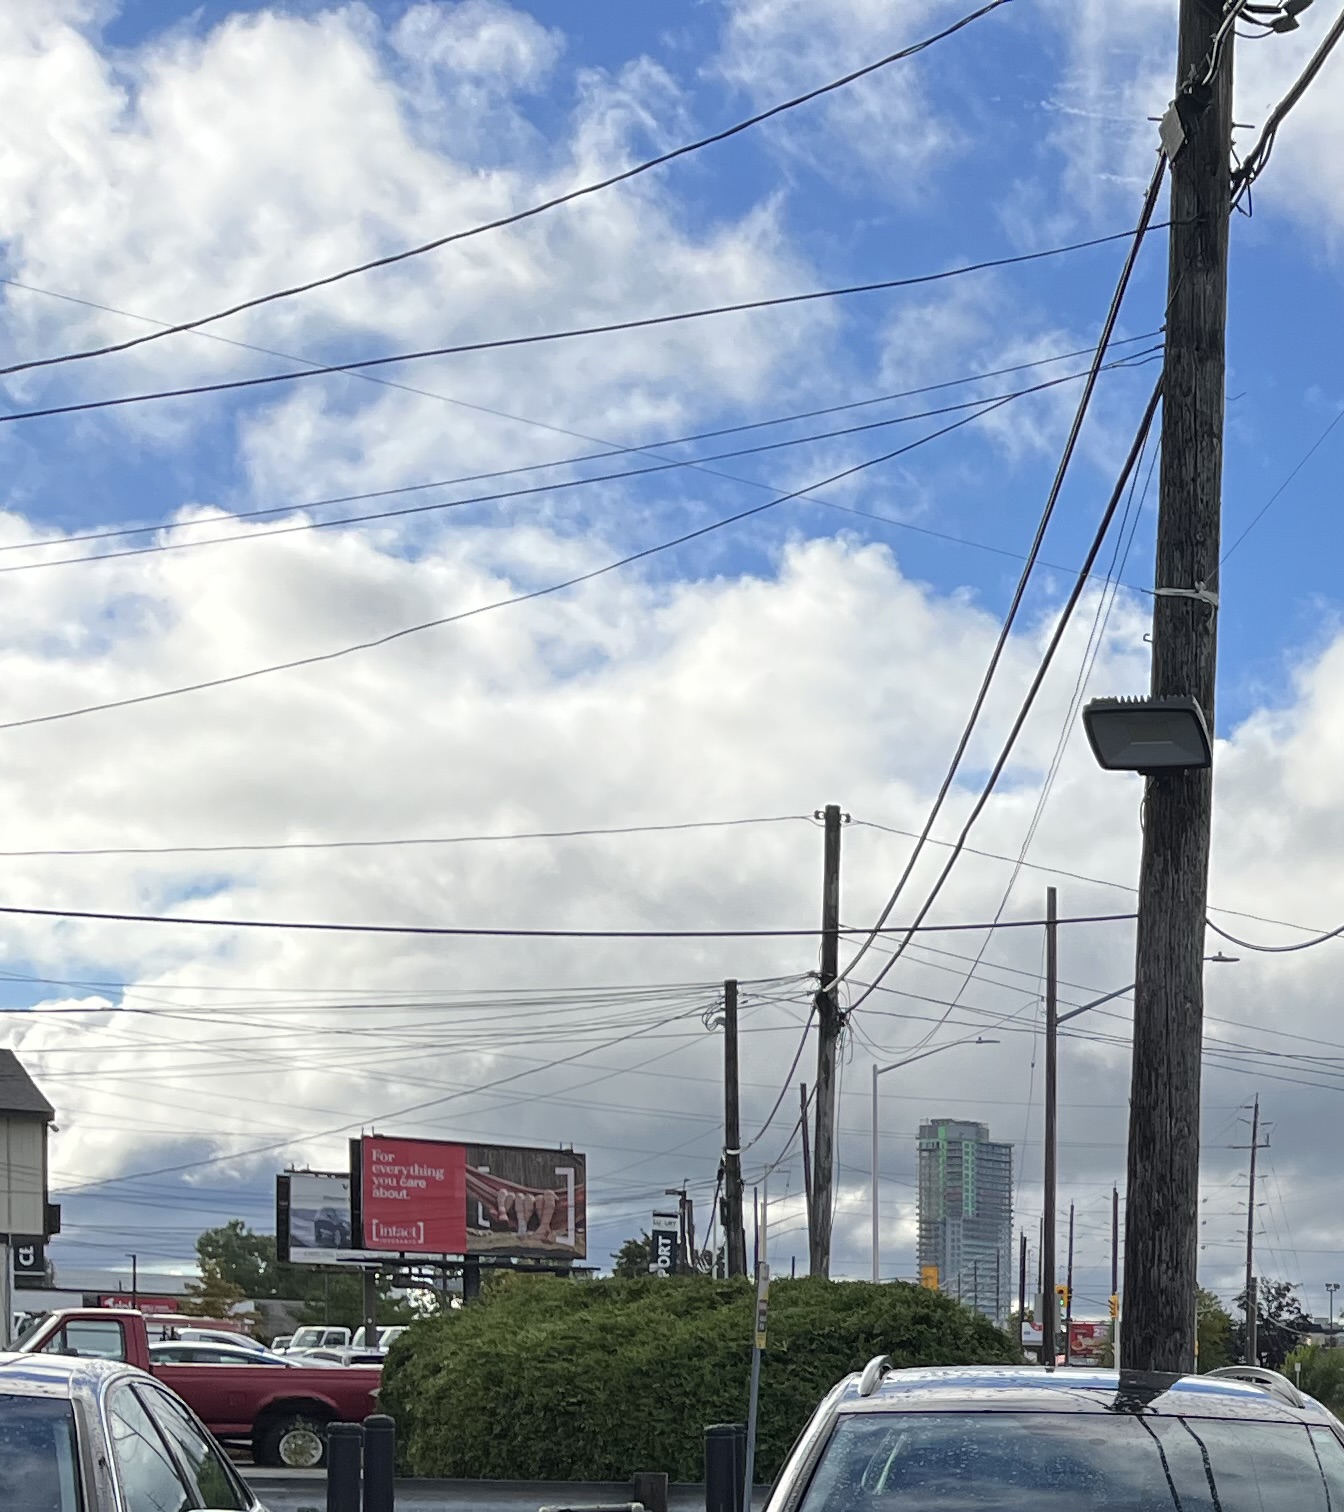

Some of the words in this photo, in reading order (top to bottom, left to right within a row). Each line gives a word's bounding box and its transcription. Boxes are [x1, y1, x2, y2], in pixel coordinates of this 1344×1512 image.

[372, 1148, 396, 1162] For
[372, 1163, 445, 1181] everything
[372, 1176, 397, 1188] you
[400, 1177, 427, 1188] care
[372, 1187, 411, 1200] about.
